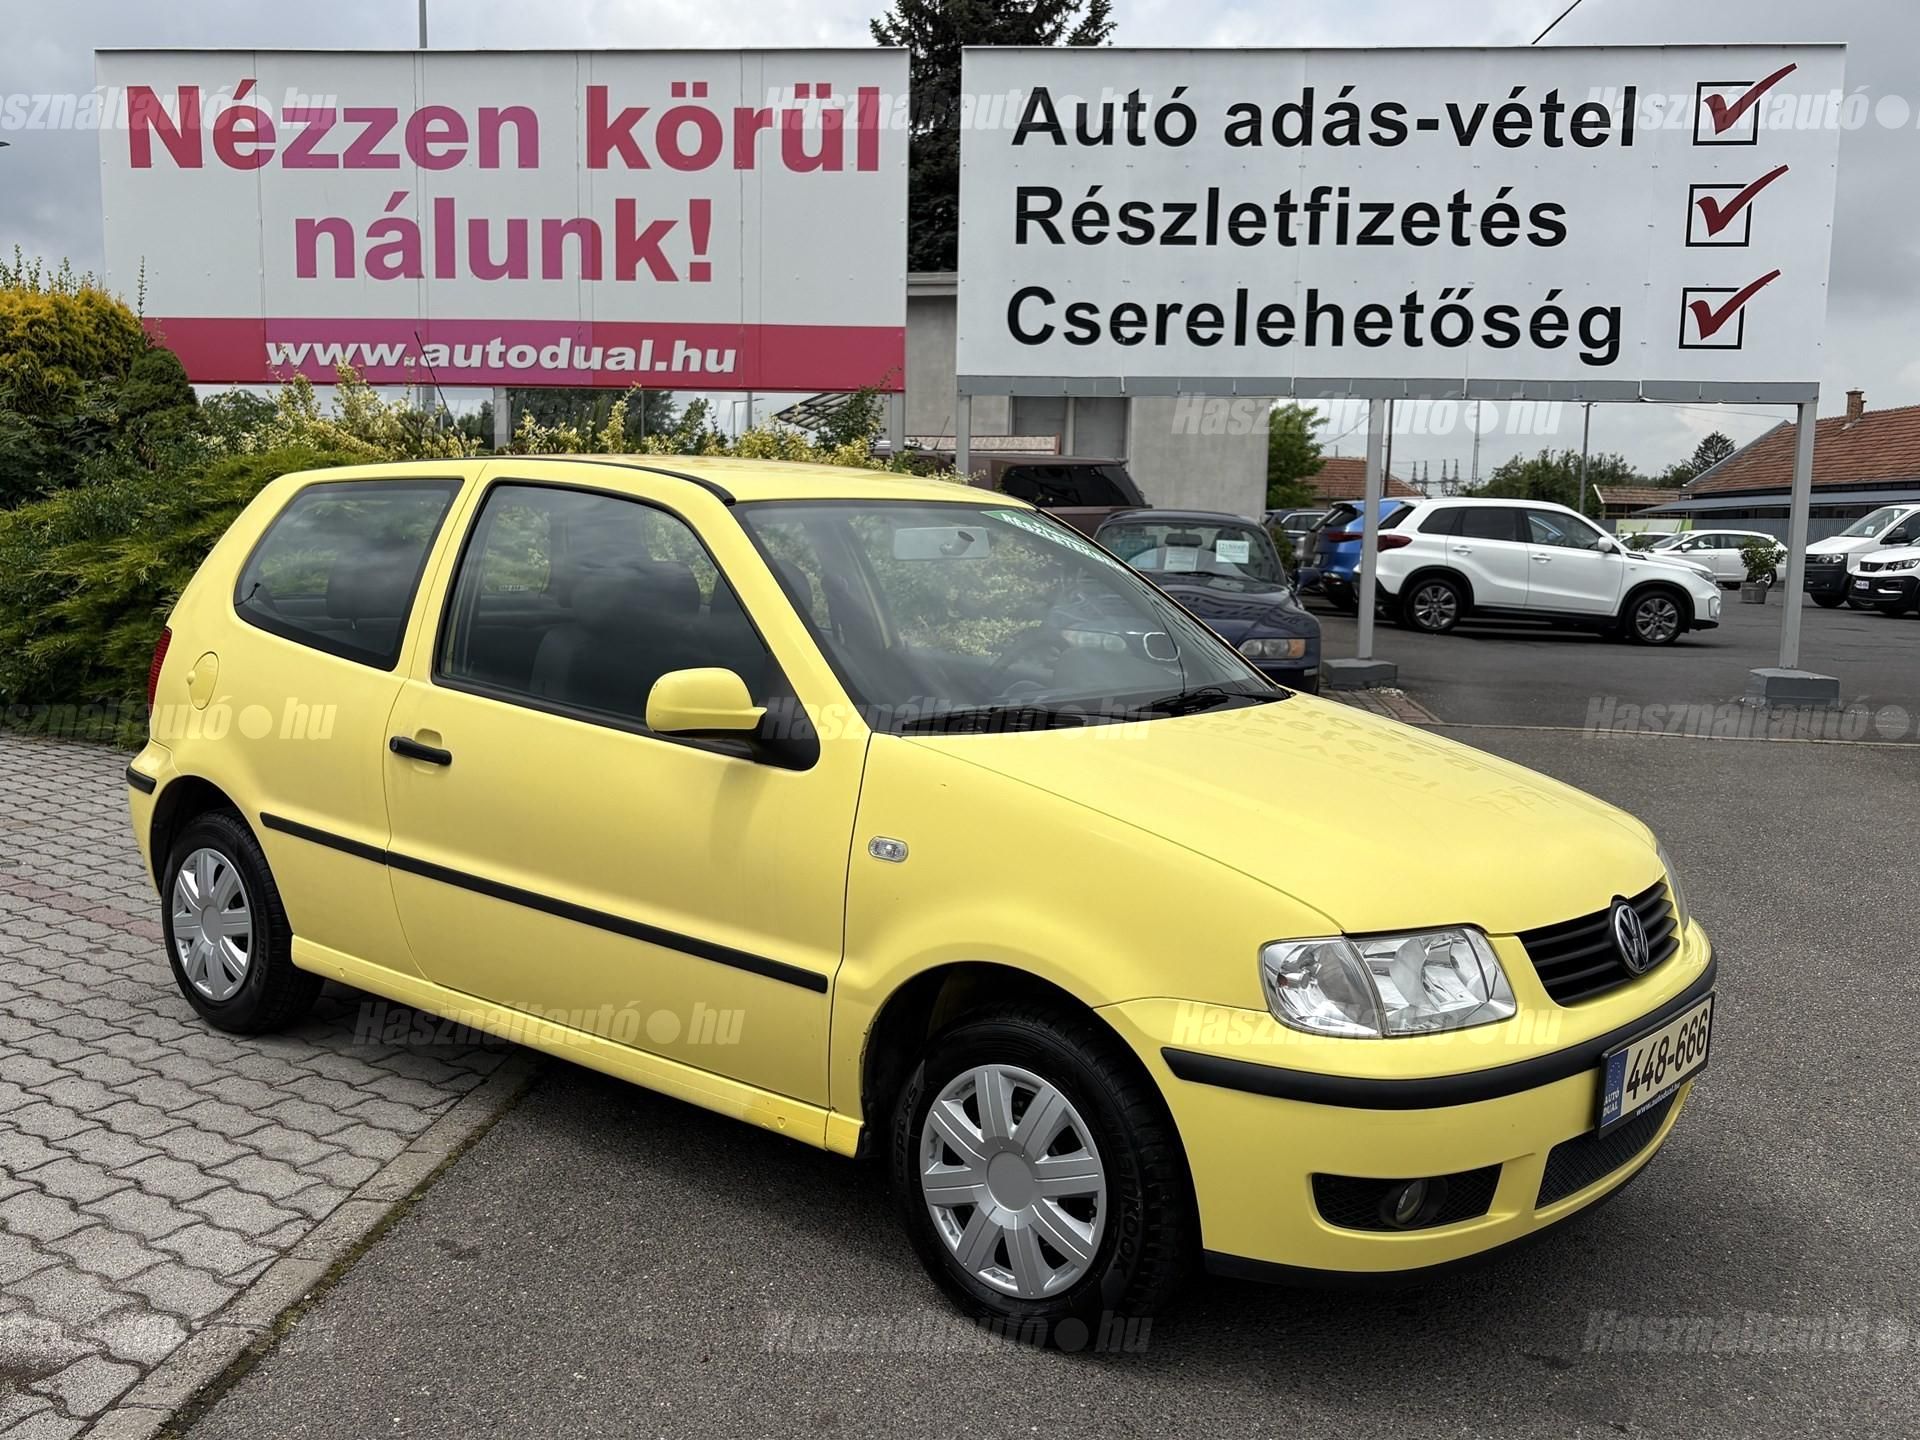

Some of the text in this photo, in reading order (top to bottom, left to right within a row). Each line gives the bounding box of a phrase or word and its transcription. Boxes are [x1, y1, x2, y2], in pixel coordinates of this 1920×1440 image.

[127, 79, 879, 173] Nézzen körül
[1012, 86, 1636, 148] Autó adás-vétel
[296, 191, 711, 283] nálunk!
[1016, 185, 1567, 248] Részletfizetés
[266, 337, 736, 373] www.autodual.hu
[1008, 287, 1620, 366] Cserelehetőség
[1626, 1008, 1708, 1100] 448-666
